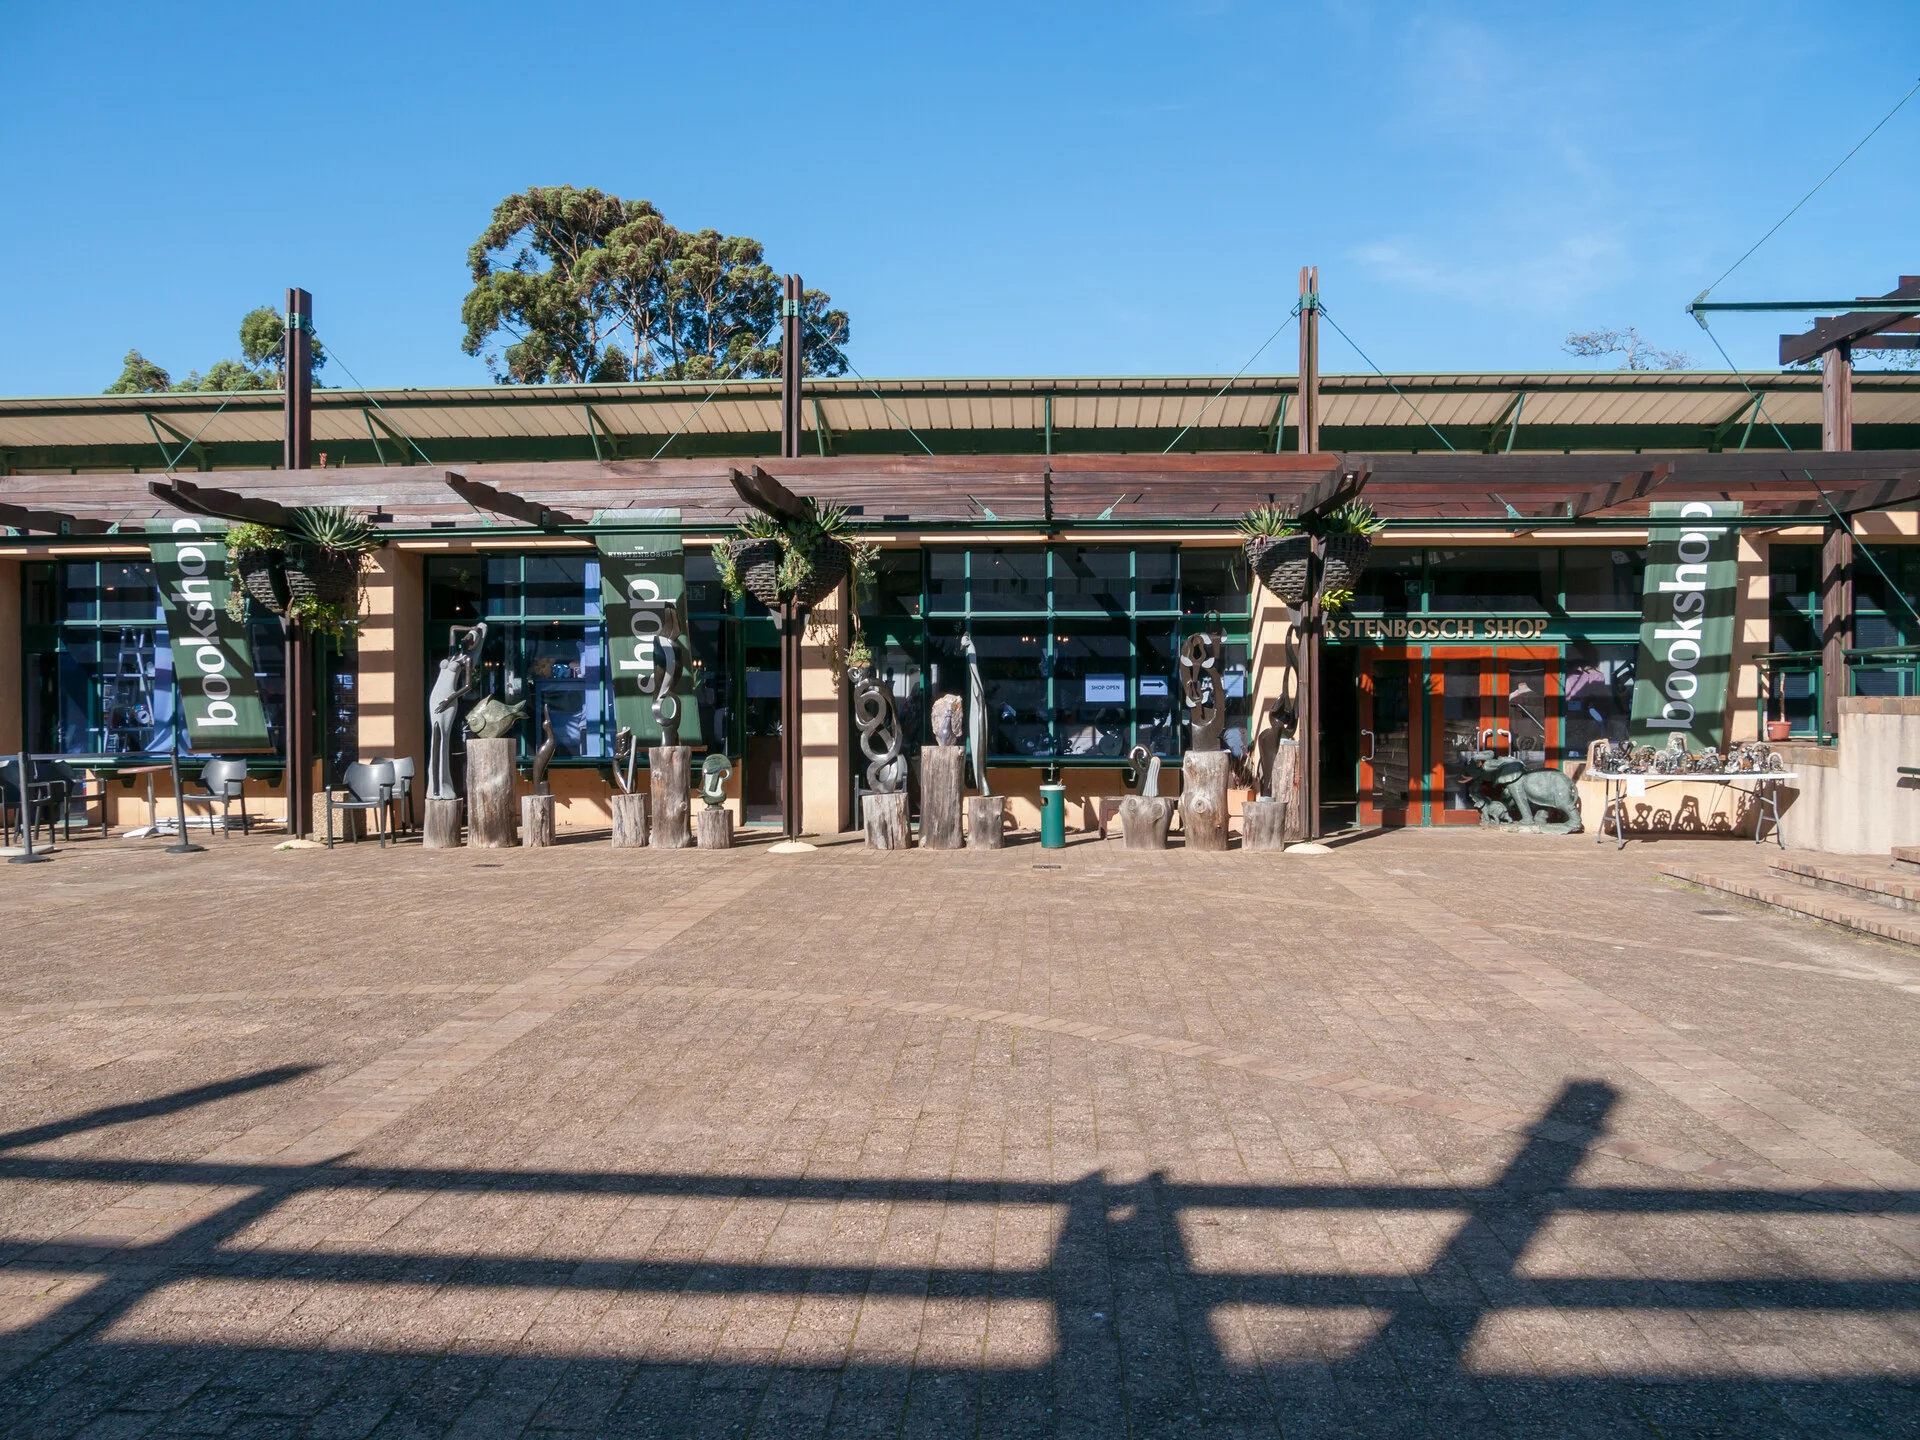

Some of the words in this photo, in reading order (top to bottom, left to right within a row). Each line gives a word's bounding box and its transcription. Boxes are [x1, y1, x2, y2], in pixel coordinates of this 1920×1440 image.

[171, 518, 239, 727] bookshop
[619, 579, 677, 694] shop
[1323, 619, 1475, 639] RSTENBOSCH
[1484, 619, 1548, 639] SHOP
[1646, 502, 1728, 729] bookshop
